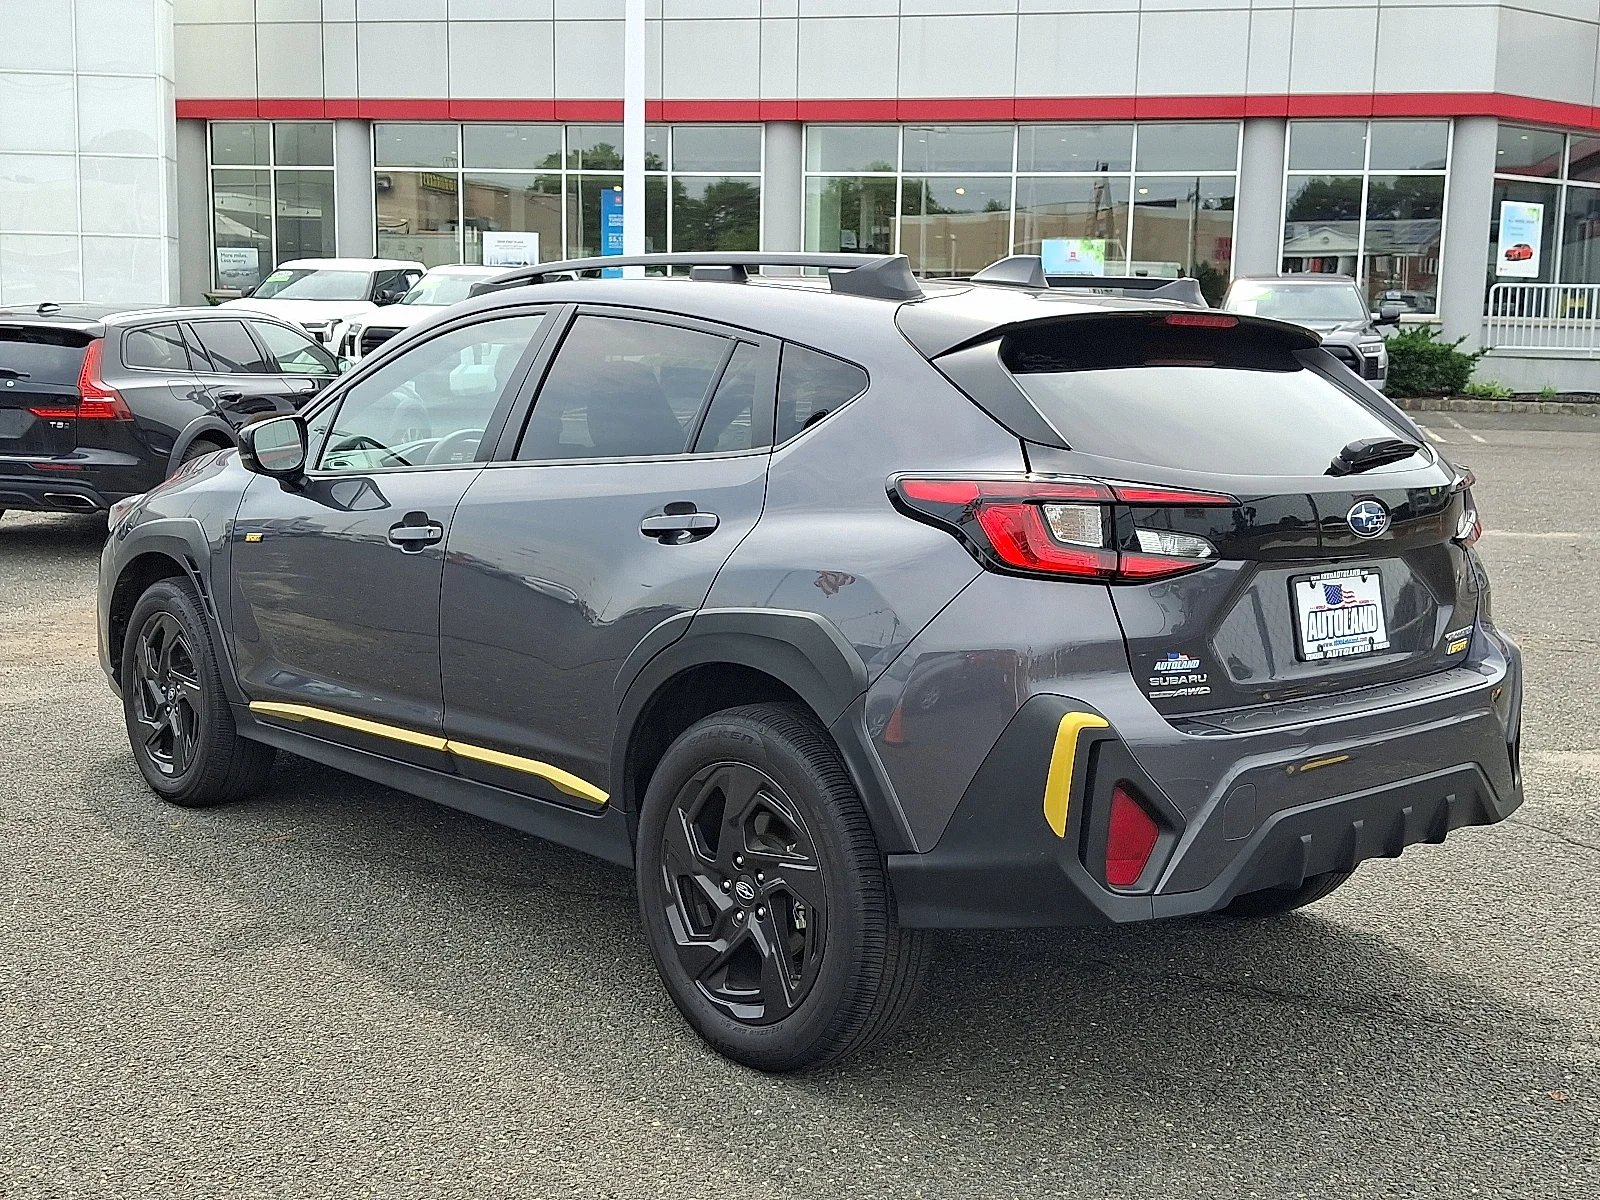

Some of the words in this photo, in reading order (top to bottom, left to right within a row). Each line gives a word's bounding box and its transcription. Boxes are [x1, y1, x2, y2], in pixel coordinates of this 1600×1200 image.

[1307, 604, 1379, 642] AUTOLAND
[1326, 643, 1371, 658] AUTOLAND
[1153, 659, 1200, 671] AUTOLAND
[1149, 674, 1208, 686] SUBARU
[1172, 686, 1211, 697] AWD
